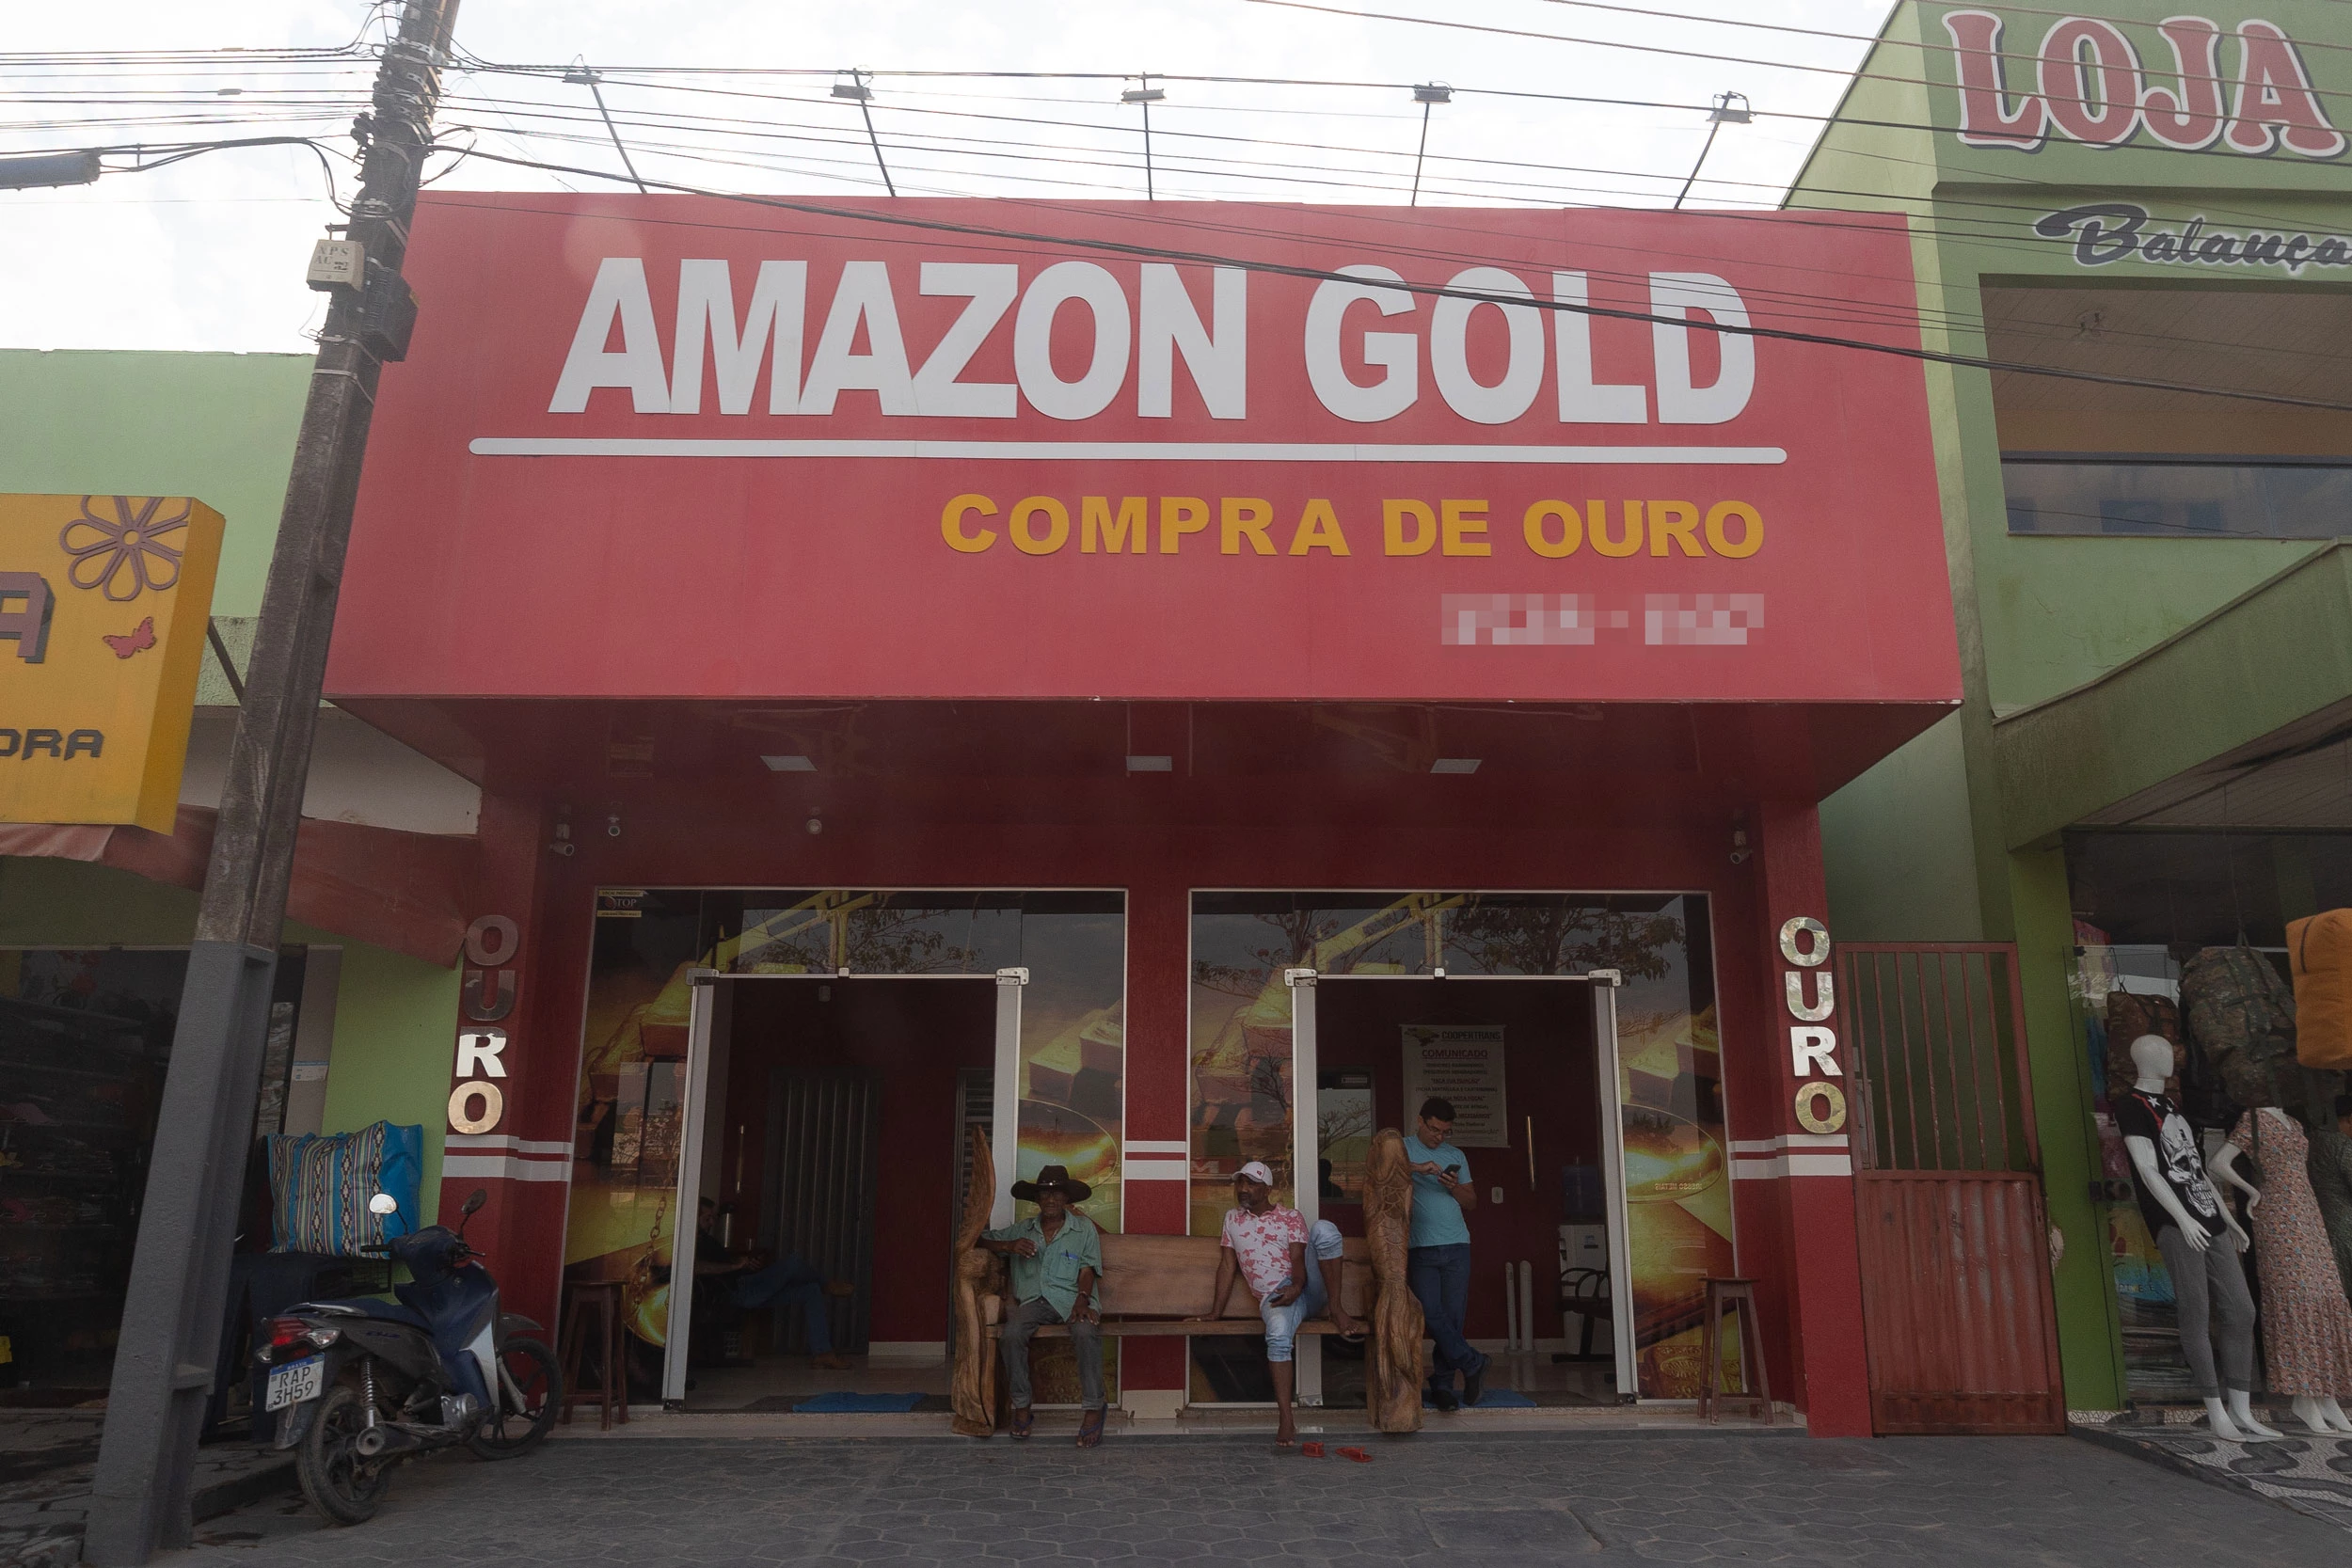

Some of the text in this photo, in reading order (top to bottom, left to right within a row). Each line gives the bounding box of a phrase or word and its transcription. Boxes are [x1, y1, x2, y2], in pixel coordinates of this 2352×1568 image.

[1942, 10, 2349, 159] LOJA
[2035, 204, 2352, 274] Balança
[548, 257, 1756, 427] AMAZON GOLD
[940, 493, 1765, 560] COMPRA DE OURO
[447, 914, 519, 1135] OURO
[1422, 1049, 1488, 1059] COMUNICADO
[1441, 1031, 1502, 1040] COOPERTRANS
[1778, 916, 1849, 1135] OURO
[270, 1380, 314, 1406] 3H59
[279, 1366, 311, 1388] RAP
